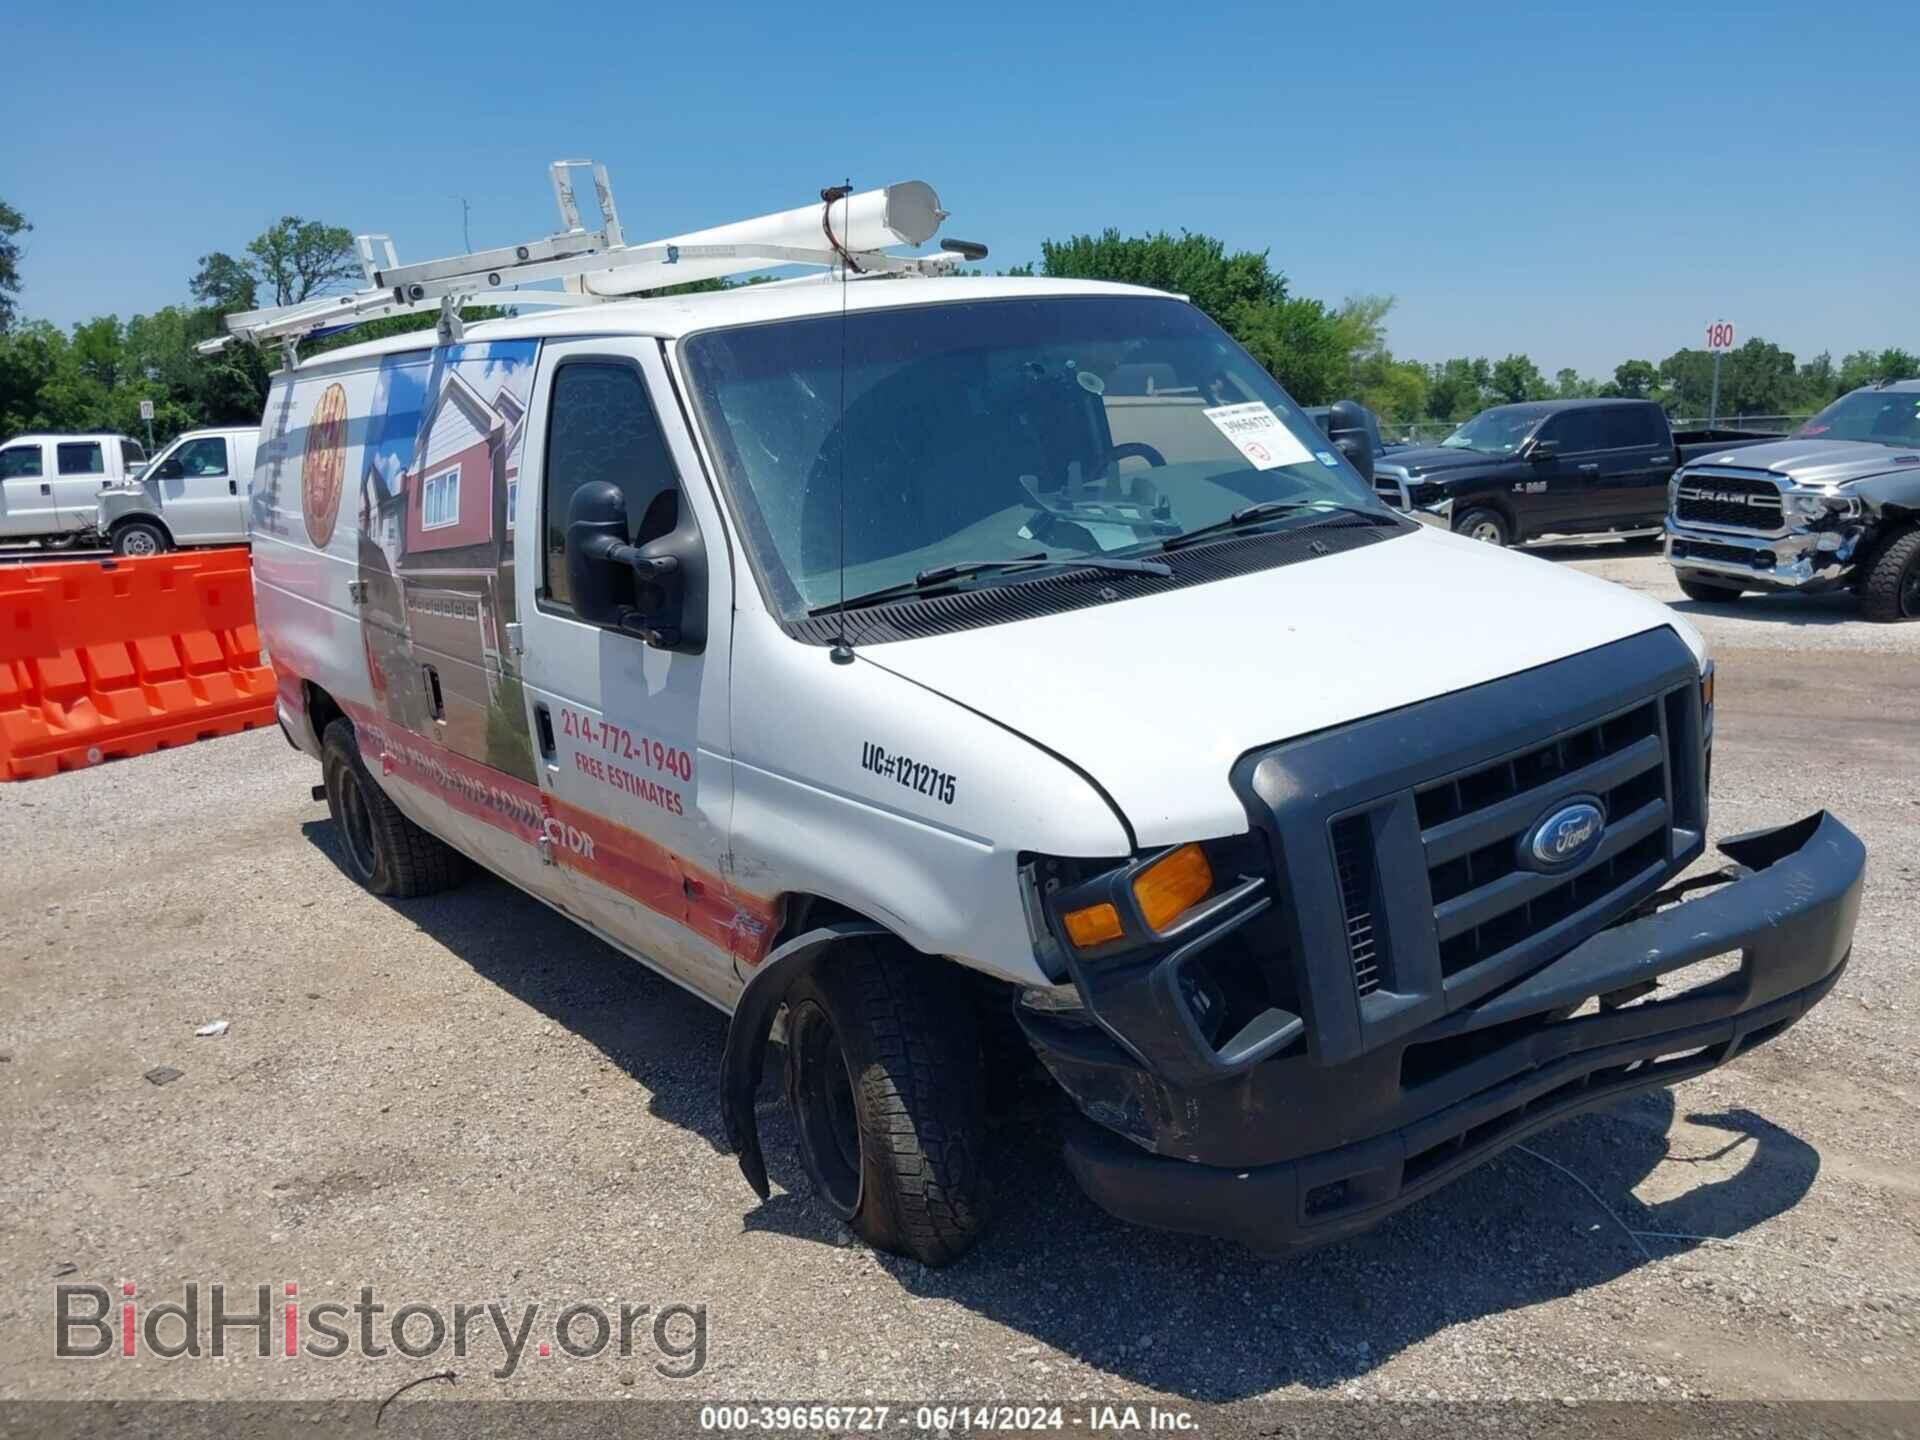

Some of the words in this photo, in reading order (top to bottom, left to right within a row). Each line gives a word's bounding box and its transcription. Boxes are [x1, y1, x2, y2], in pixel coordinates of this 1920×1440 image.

[1706, 322, 1733, 348] 180
[1700, 490, 1746, 504] RAM
[560, 708, 692, 783] 214-772-1940
[574, 751, 605, 782] FREE
[607, 764, 683, 816] ESTIMATES
[862, 740, 957, 806] LIC#1212715
[1556, 815, 1592, 853] Ford
